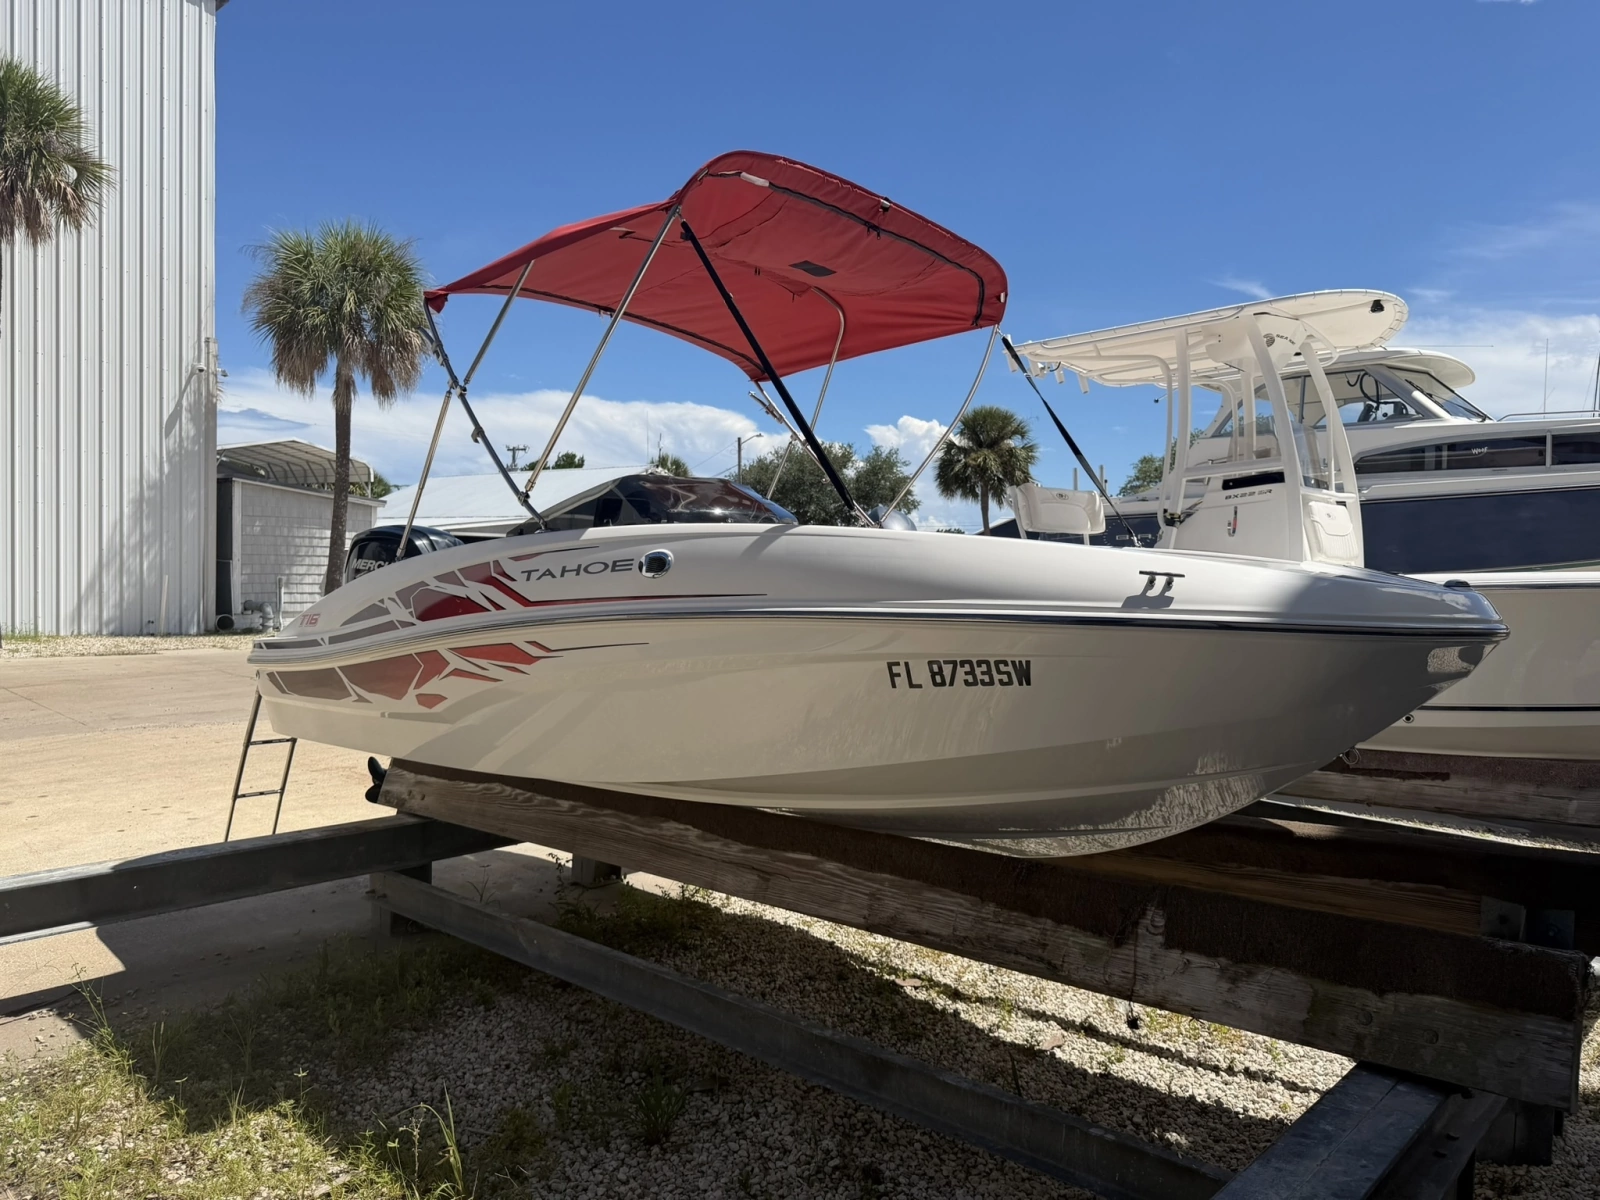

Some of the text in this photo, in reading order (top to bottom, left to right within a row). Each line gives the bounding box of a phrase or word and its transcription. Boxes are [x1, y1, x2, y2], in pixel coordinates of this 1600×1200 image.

[351, 558, 389, 570] MERC
[521, 558, 635, 582] TAHOE
[886, 659, 1031, 689] FL 8733SW
